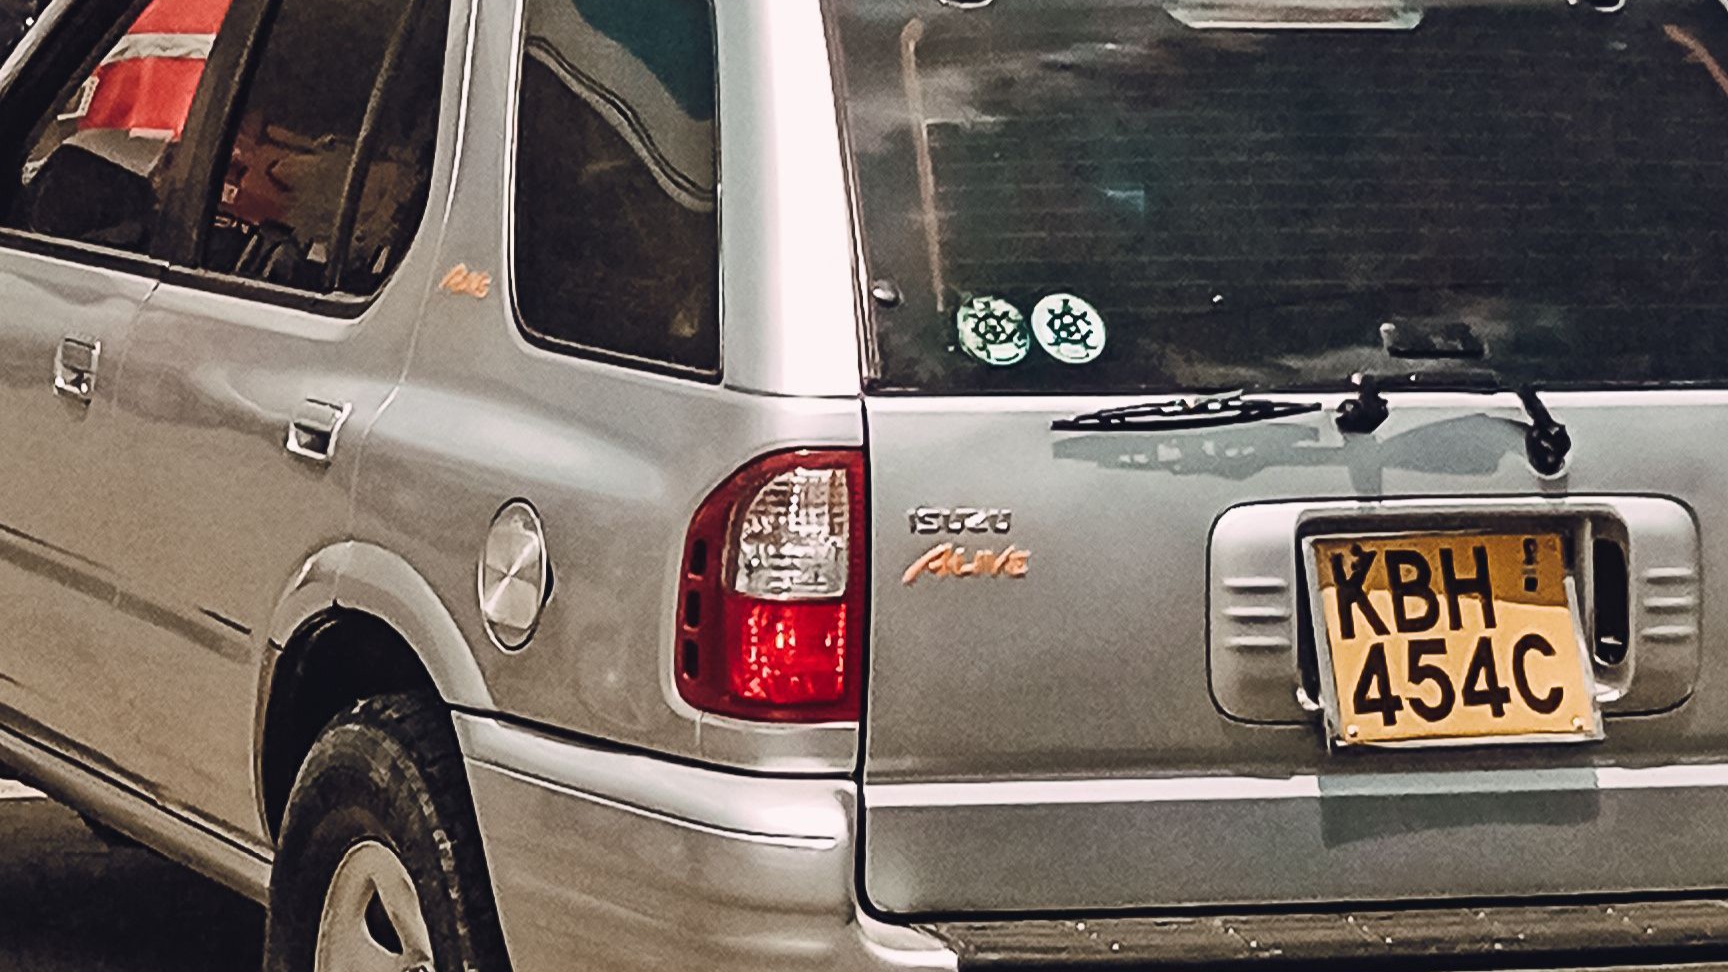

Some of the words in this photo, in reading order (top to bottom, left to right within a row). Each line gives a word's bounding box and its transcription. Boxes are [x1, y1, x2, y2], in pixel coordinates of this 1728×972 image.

[908, 505, 1012, 535] ISUZU
[1330, 542, 1497, 640] KBH
[1353, 632, 1565, 726] 454C
